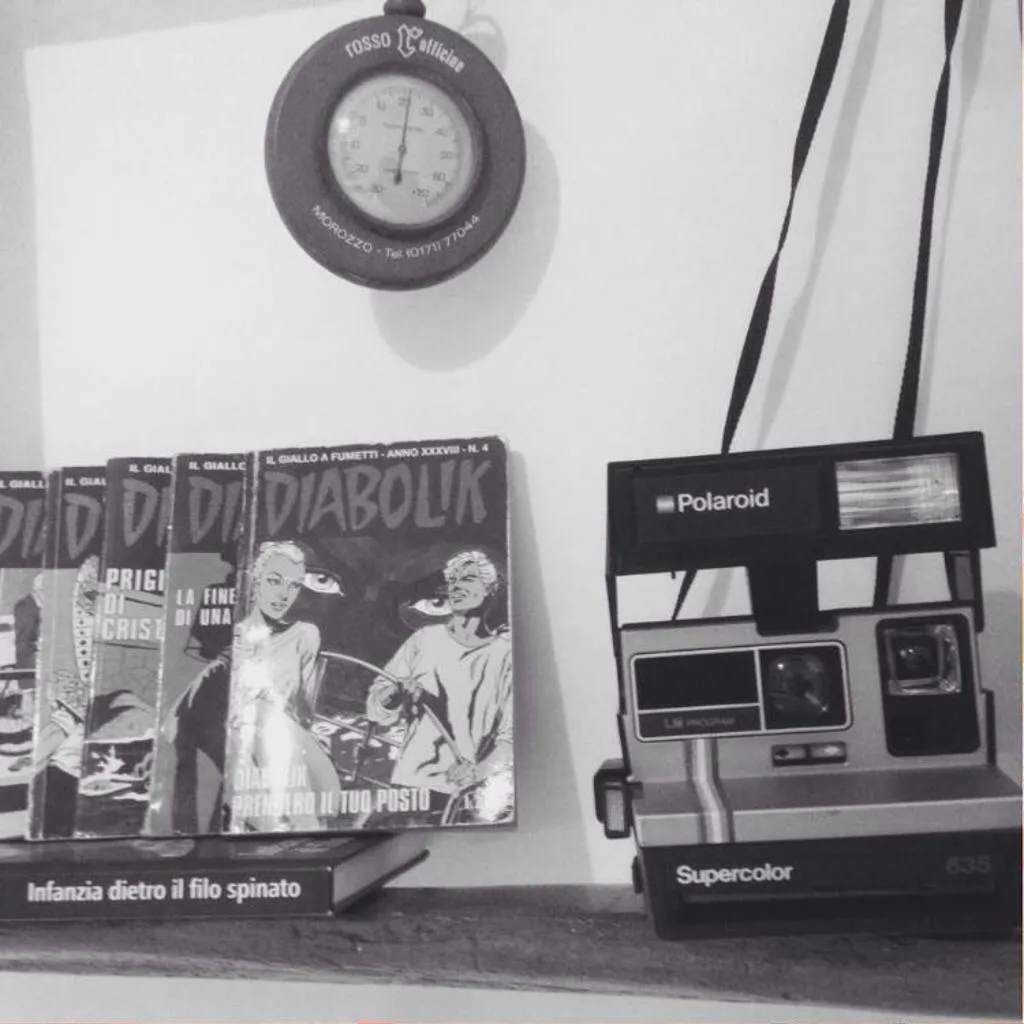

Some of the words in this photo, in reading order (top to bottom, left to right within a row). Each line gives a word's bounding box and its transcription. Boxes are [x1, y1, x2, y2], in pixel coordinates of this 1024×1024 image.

[311, 205, 373, 254] MOROZZO
[444, 214, 480, 247] 77044
[266, 455, 275, 465] IL
[278, 452, 318, 464] GIALLO
[321, 451, 328, 461] A
[331, 450, 378, 461] FUMETTI
[387, 447, 419, 458] ANNO
[482, 443, 488, 452] 4
[263, 459, 492, 536] DIABOLIK
[678, 487, 769, 512] Polaroid
[104, 593, 125, 614] DI
[176, 588, 194, 605] LA
[204, 587, 236, 605] FINE
[175, 609, 191, 626] DI
[200, 608, 231, 626] UNA
[340, 789, 371, 815] TUO
[376, 788, 429, 814] POSTO
[676, 863, 793, 888] Supercolor
[27, 880, 103, 902] Infanzia
[107, 879, 166, 900] dietro
[171, 878, 184, 899] il
[189, 877, 221, 900] filo
[227, 877, 301, 904] spinato
